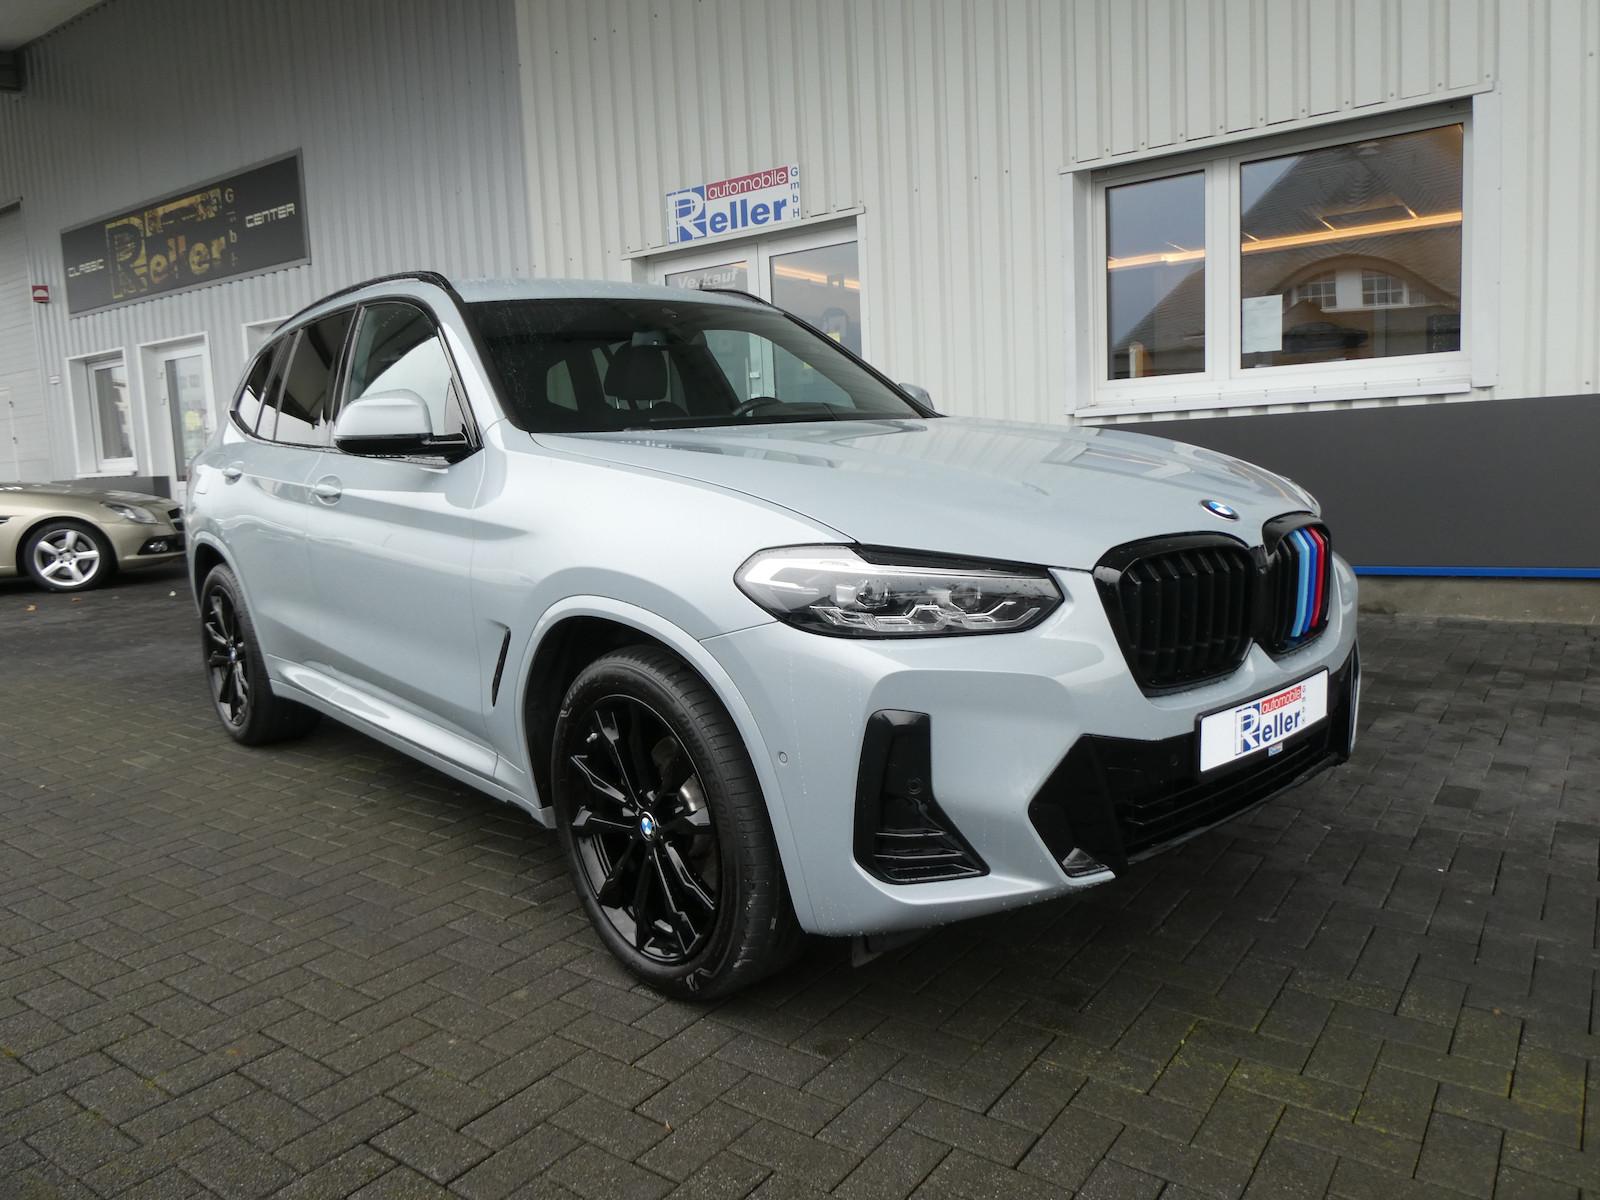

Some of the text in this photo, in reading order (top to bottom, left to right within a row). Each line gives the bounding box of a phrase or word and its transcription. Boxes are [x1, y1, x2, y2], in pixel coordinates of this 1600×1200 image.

[708, 168, 788, 200] automobile
[245, 203, 297, 228] CENTER
[666, 185, 788, 244] Reller
[1262, 687, 1301, 714] automobile
[1235, 703, 1300, 755] Reller
